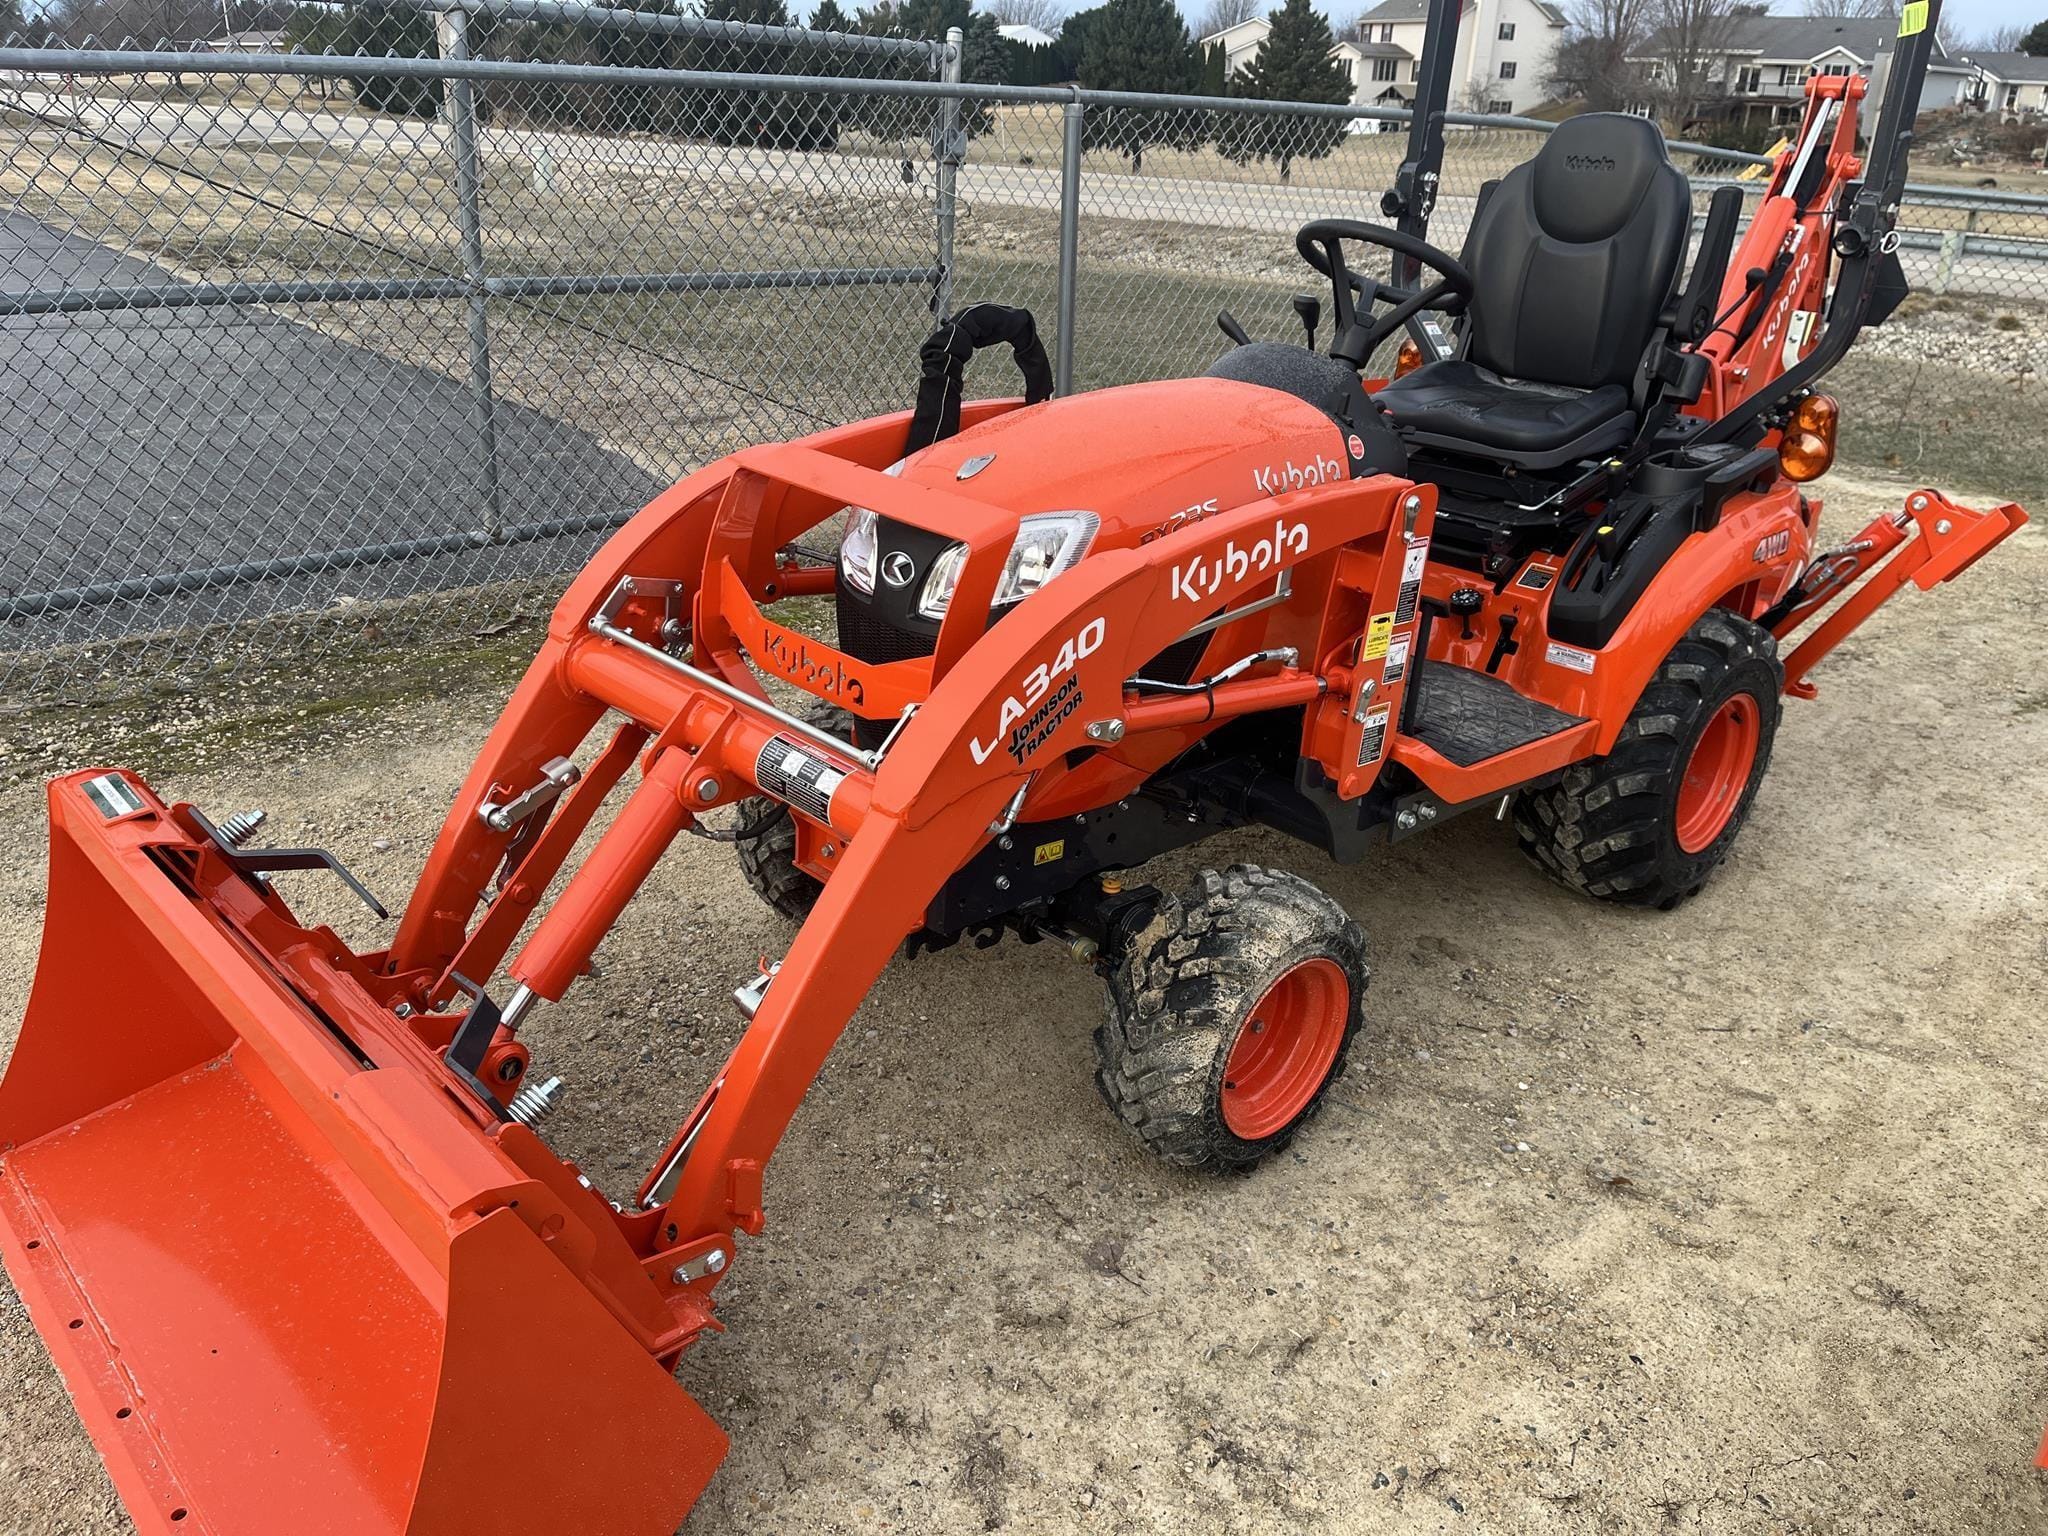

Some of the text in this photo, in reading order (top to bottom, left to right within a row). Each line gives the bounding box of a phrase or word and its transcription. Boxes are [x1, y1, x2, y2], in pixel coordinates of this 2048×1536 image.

[1566, 155, 1616, 171] Kubota
[1762, 252, 1809, 349] Kubota
[1253, 454, 1341, 496] Kubota
[1171, 519, 1309, 603] Kubota
[1753, 529, 1790, 563] 4WD
[764, 629, 864, 707] Kubota
[969, 616, 1106, 766] LA340
[1007, 673, 1079, 753] JOHNSON
[1012, 690, 1084, 766] TRACTOR
